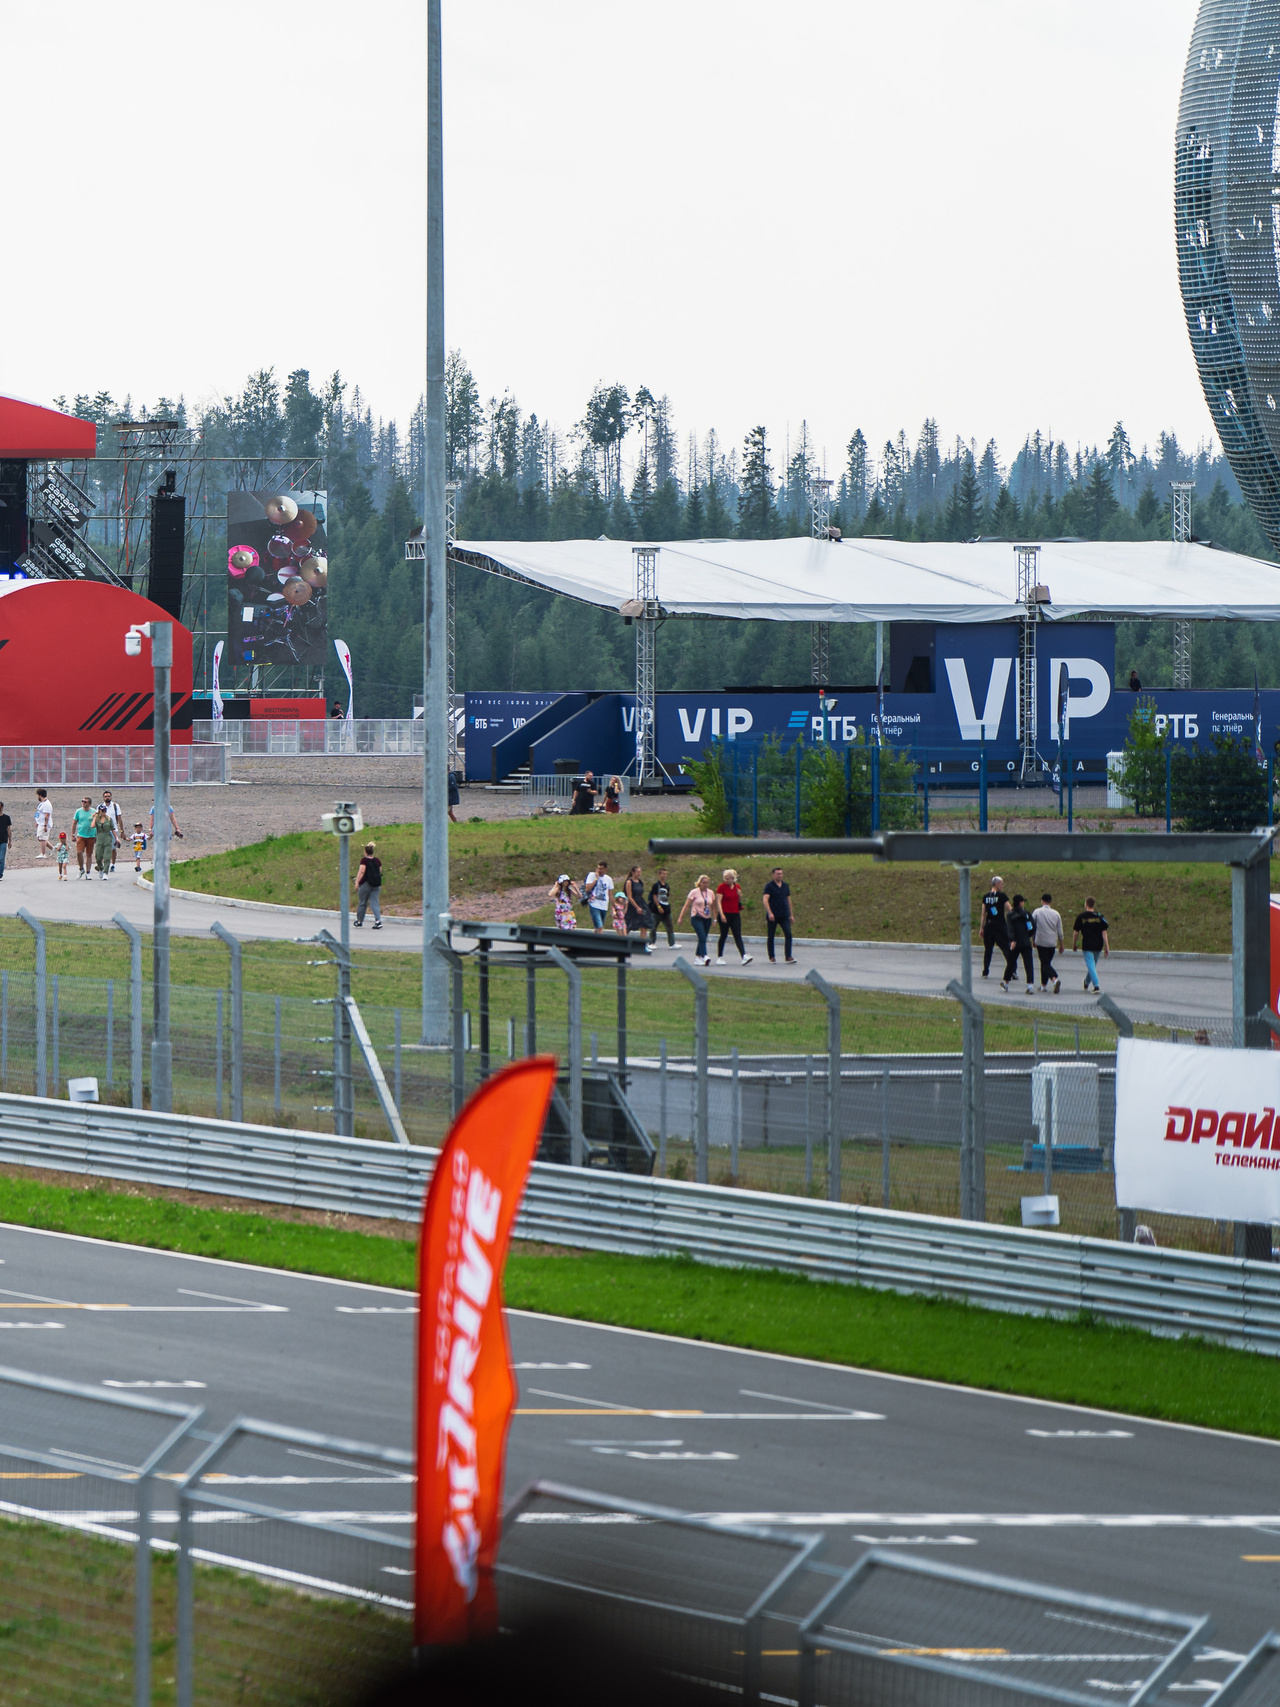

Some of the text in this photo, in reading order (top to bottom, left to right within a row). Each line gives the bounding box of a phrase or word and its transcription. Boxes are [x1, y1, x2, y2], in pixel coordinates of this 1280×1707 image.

[25, 559, 48, 579] GARAG
[944, 658, 1111, 740] VIP
[475, 718, 488, 729] ВТБ
[512, 717, 527, 729] VIP
[678, 708, 754, 742] VIP
[871, 713, 921, 723] Гееральный
[1154, 714, 1199, 739] ВТБ
[812, 716, 858, 741] ВТБ
[871, 726, 903, 737] патнёр
